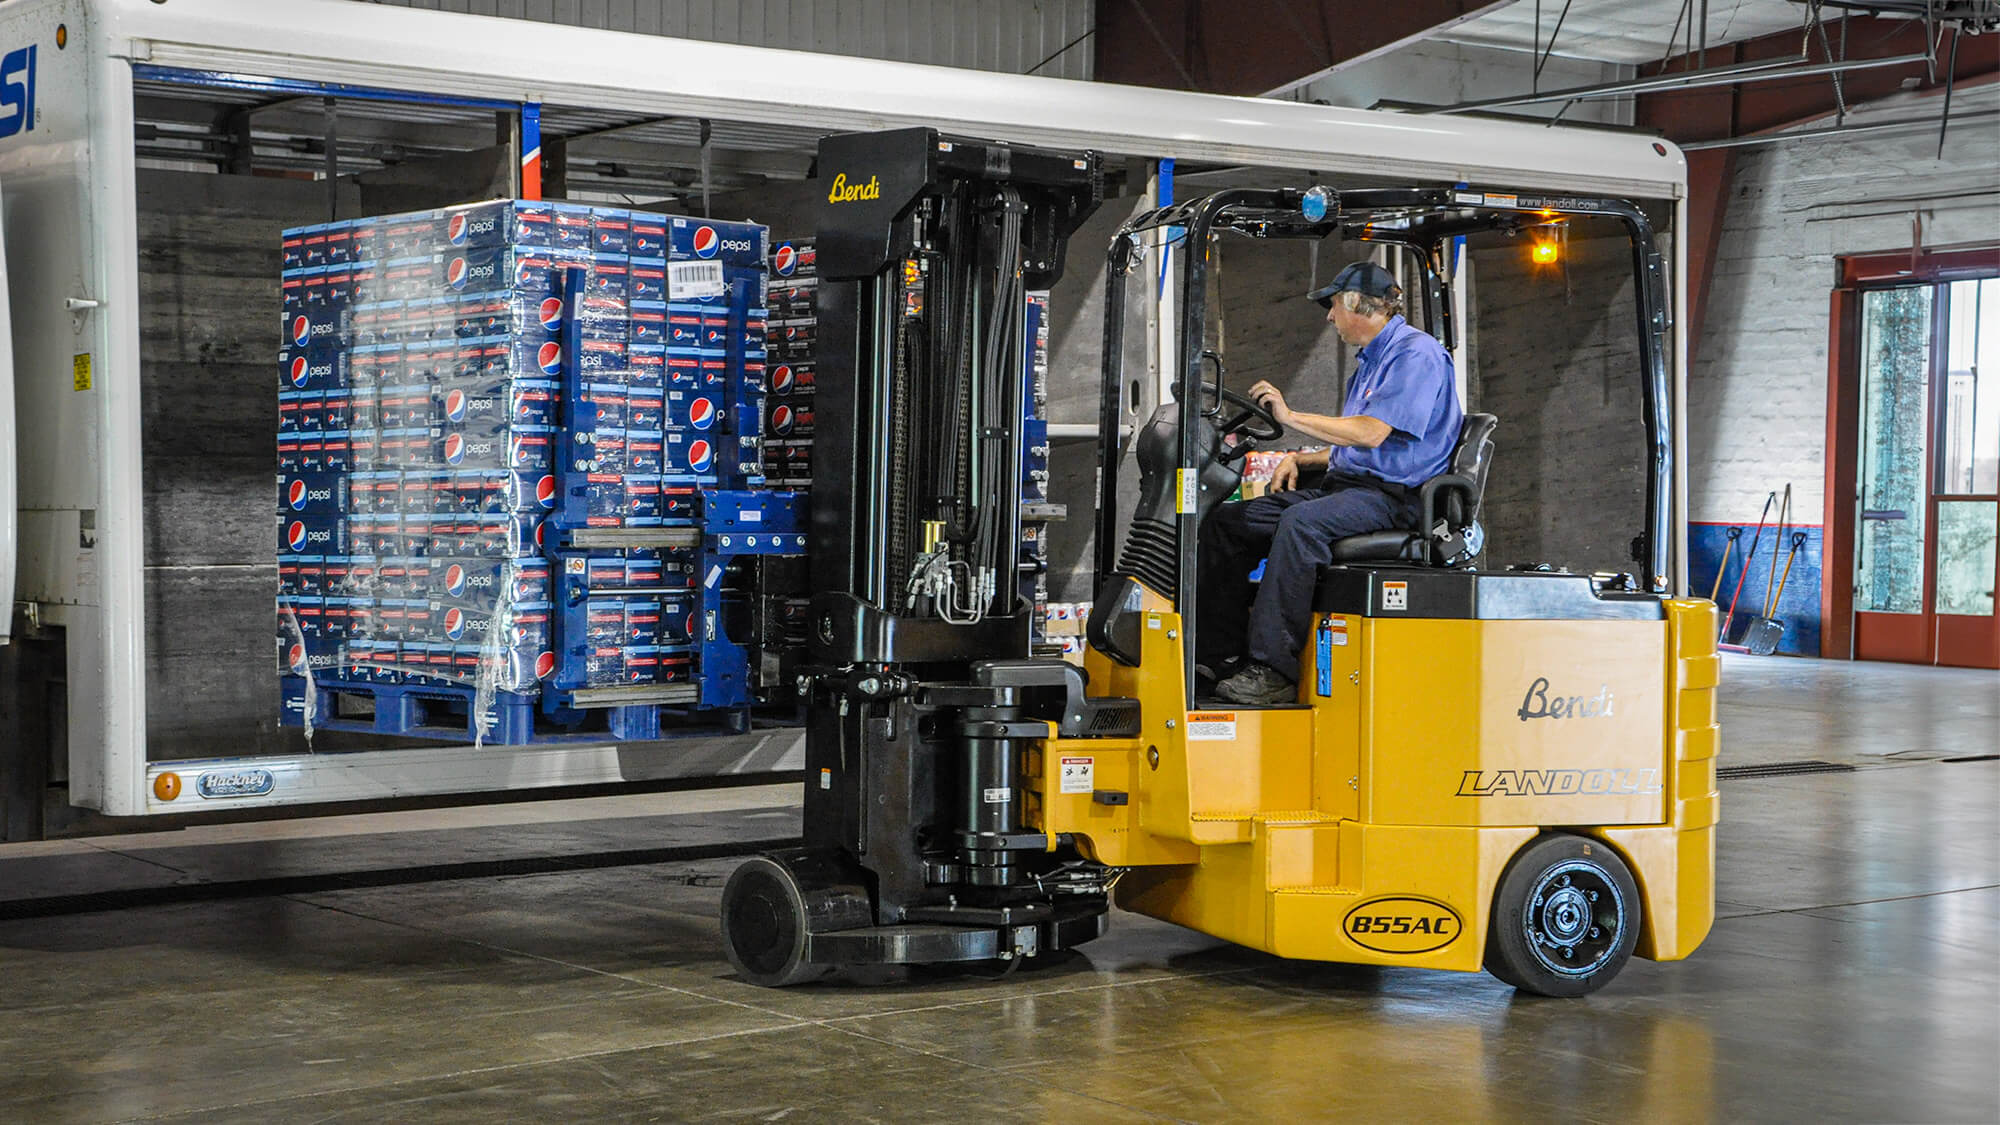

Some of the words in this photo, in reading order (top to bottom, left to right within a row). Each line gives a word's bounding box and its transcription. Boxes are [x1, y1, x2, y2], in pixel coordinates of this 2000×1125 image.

[828, 172, 880, 203] Bendi
[1519, 197, 1598, 209] www.landoll.com
[469, 219, 495, 235] pepsi
[720, 239, 751, 252] pepsi
[469, 263, 494, 278] pepsi
[311, 322, 334, 336] pepsi
[309, 364, 332, 378] pepsi
[468, 397, 493, 412] pepsi
[466, 442, 491, 456] pepsi
[308, 488, 331, 502] pepsi
[308, 529, 331, 543] pepsi
[467, 575, 492, 588] pepsi
[465, 618, 491, 632] pepsi
[308, 654, 332, 666] pepsi
[1517, 677, 1614, 721] Bendi
[206, 772, 266, 788] Hackney
[1455, 768, 1663, 796] LANDOLL
[1351, 917, 1452, 935] B55AC
